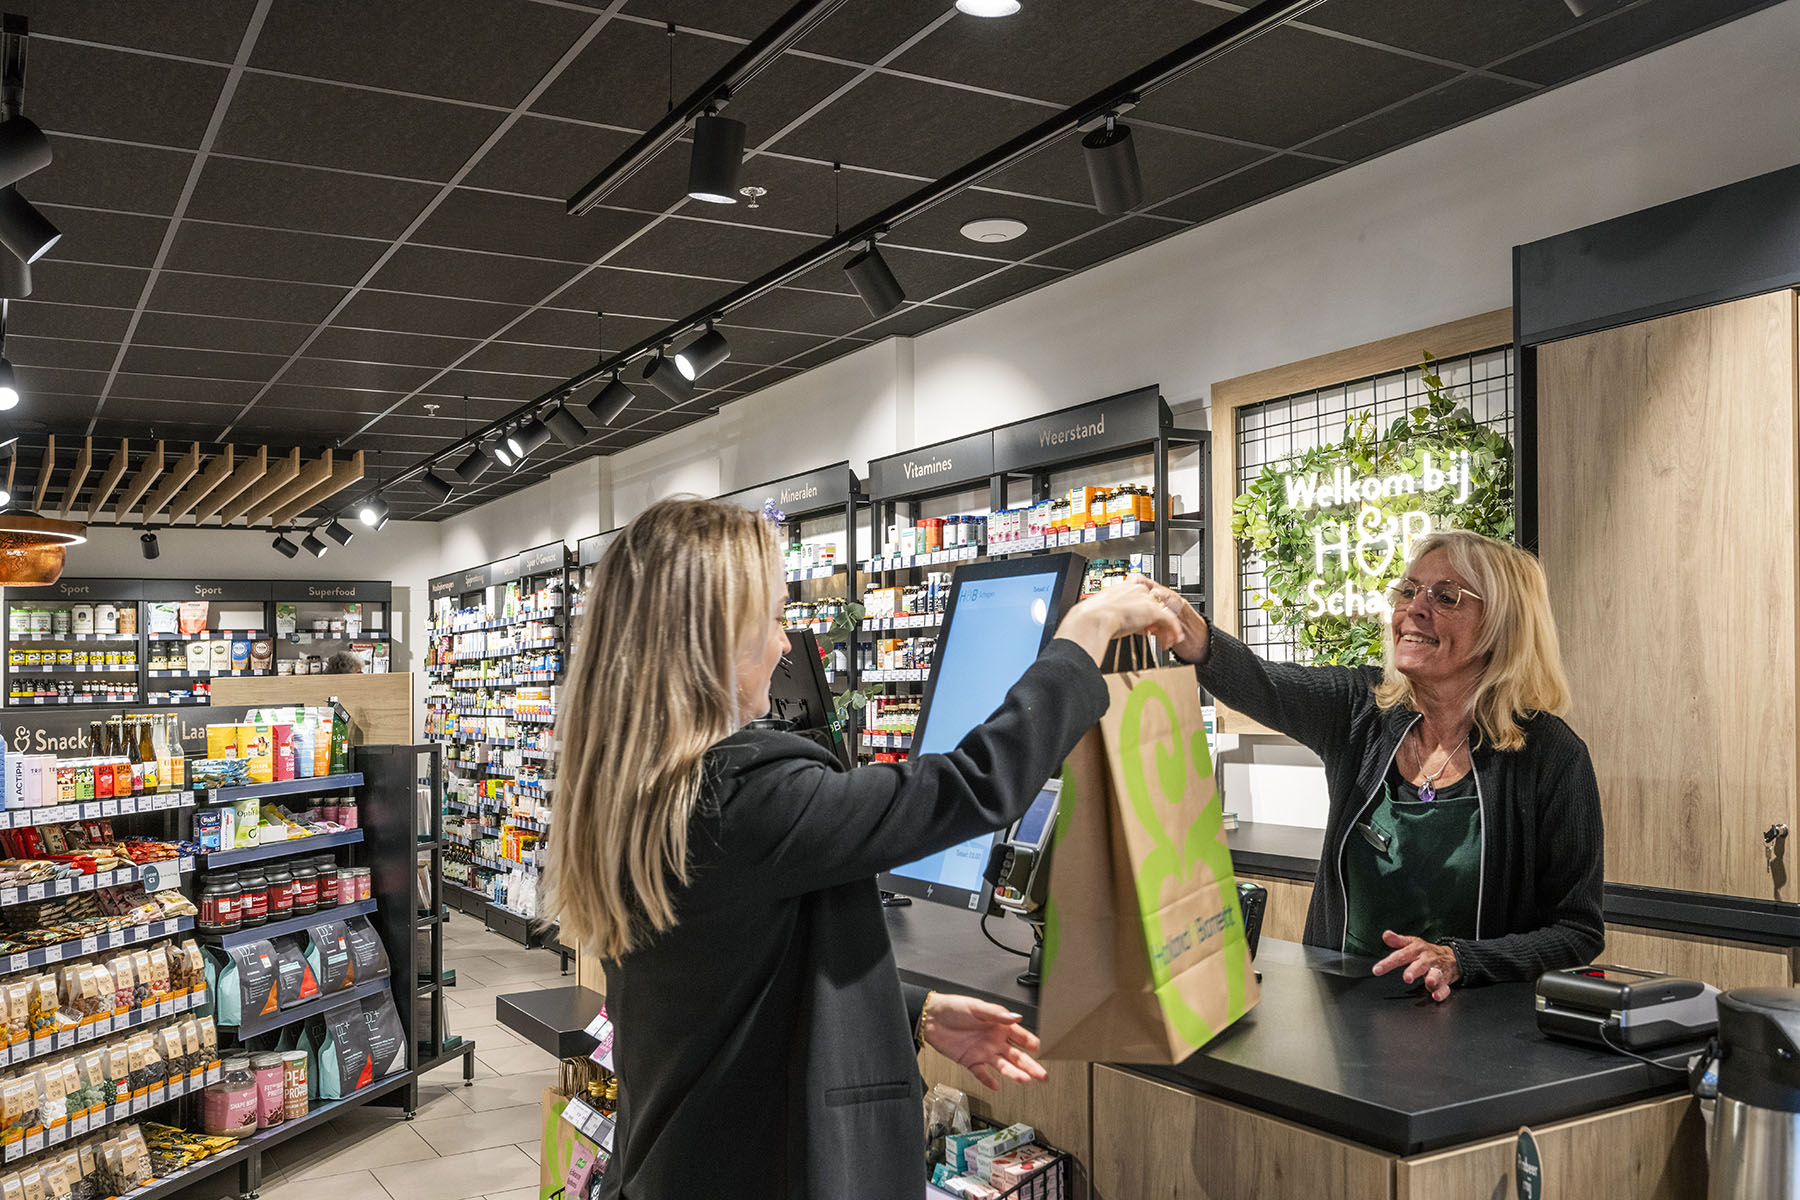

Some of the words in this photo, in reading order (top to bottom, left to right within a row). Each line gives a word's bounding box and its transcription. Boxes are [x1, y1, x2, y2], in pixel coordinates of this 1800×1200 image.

[1038, 414, 1106, 449] Weerstand
[903, 456, 952, 480] Vitamines
[1285, 466, 1414, 509] Welkom
[1422, 450, 1470, 504] bij
[780, 483, 818, 505] Mineralen
[60, 583, 90, 596] Sport
[194, 584, 222, 597] Sport
[308, 586, 356, 598] Superfood
[284, 1068, 305, 1088] PEA
